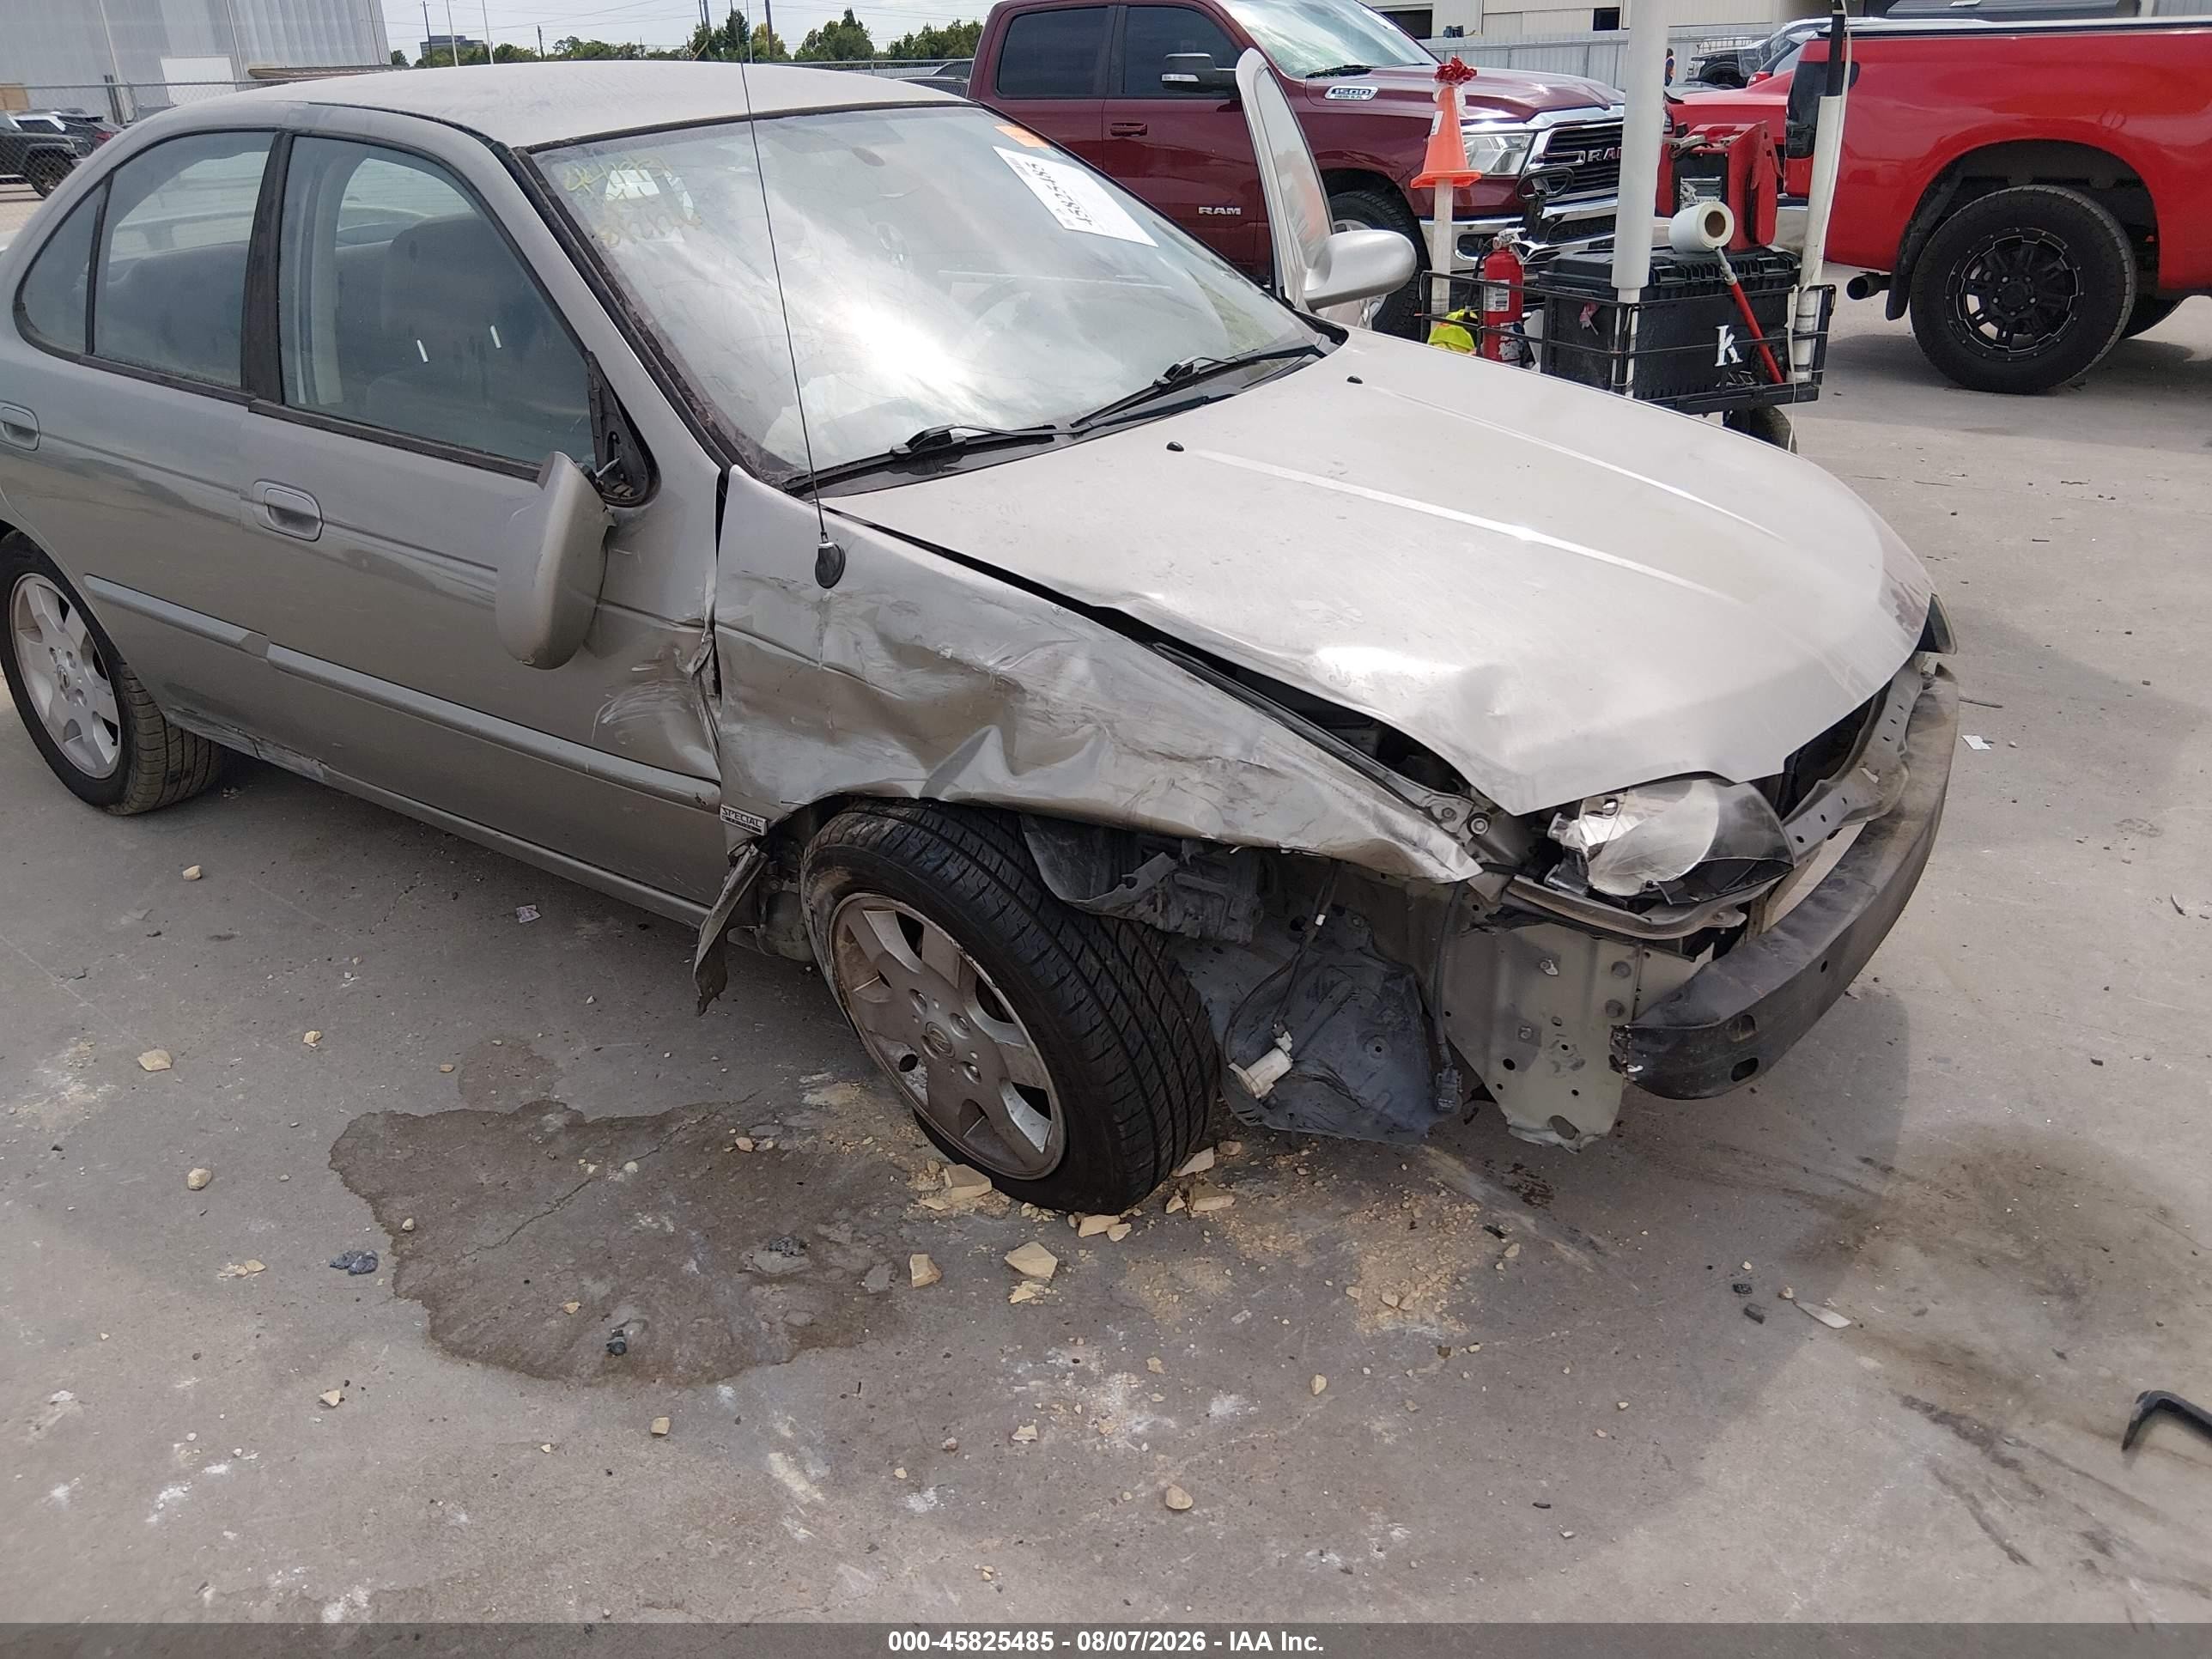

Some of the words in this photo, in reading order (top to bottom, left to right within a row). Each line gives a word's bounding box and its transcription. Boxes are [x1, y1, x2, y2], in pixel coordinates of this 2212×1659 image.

[1587, 147, 1622, 162] RA
[1198, 206, 1242, 216] RAM
[721, 807, 763, 828] SPECIAL
